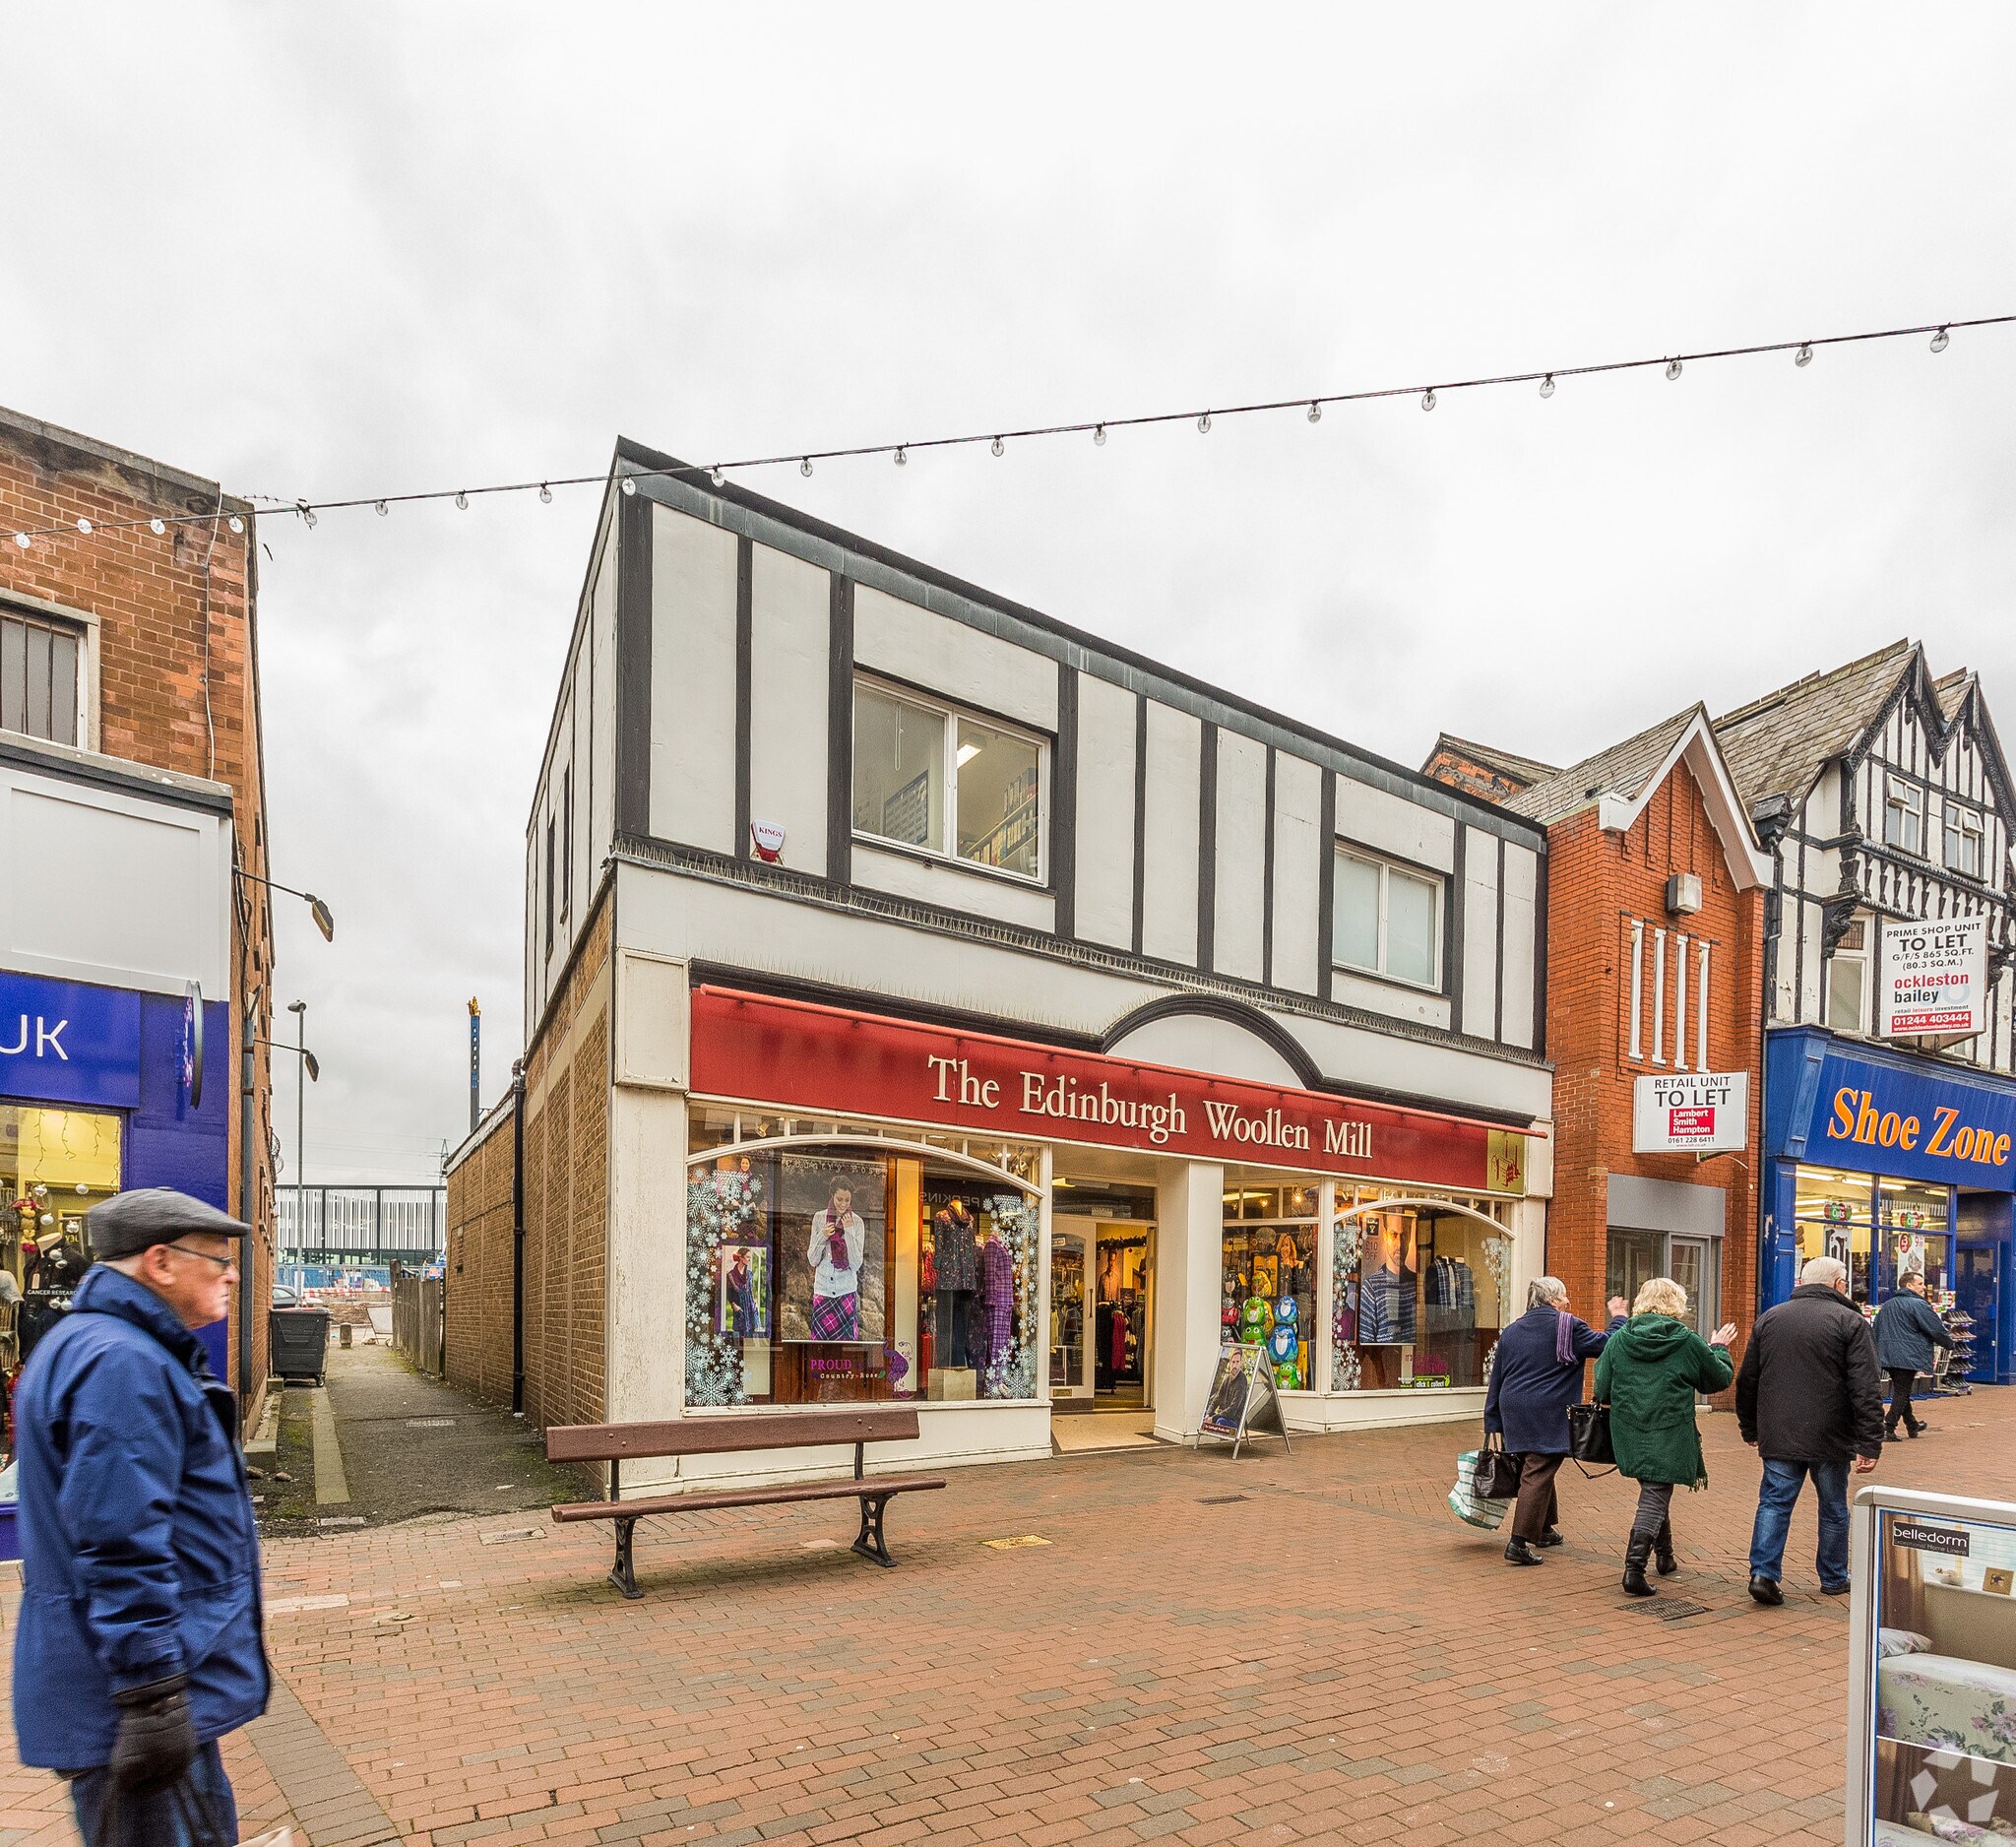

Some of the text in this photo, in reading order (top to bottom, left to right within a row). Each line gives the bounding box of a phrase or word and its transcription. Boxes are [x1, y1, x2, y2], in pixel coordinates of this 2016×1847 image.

[759, 827, 783, 838] KINGS
[1886, 923, 1981, 938] PRIME SHOP UNIT
[1899, 934, 1967, 952] TO LET
[1892, 947, 1974, 962] G/F/S 865 SQ.FT.
[1902, 958, 1963, 972] (80.3 SQ.M.)
[1894, 973, 1969, 989] ockleston
[1894, 989, 1939, 1004] bailey
[1894, 1012, 1969, 1026] 01244 403444
[0, 1014, 69, 1060] UK
[1655, 1076, 1731, 1089] RETAIL UNIT
[1655, 1088, 1731, 1108] TO LET
[927, 1054, 1374, 1160] The Edinburgh Woollen Mill
[1673, 1109, 1709, 1117] Lambert
[1673, 1125, 1711, 1135] Hampton
[1827, 1086, 2011, 1167] Shoe Zone
[810, 1359, 852, 1370] PROUD
[1894, 1525, 1968, 1548] belledorm
[1946, 1547, 1967, 1556] Linens
